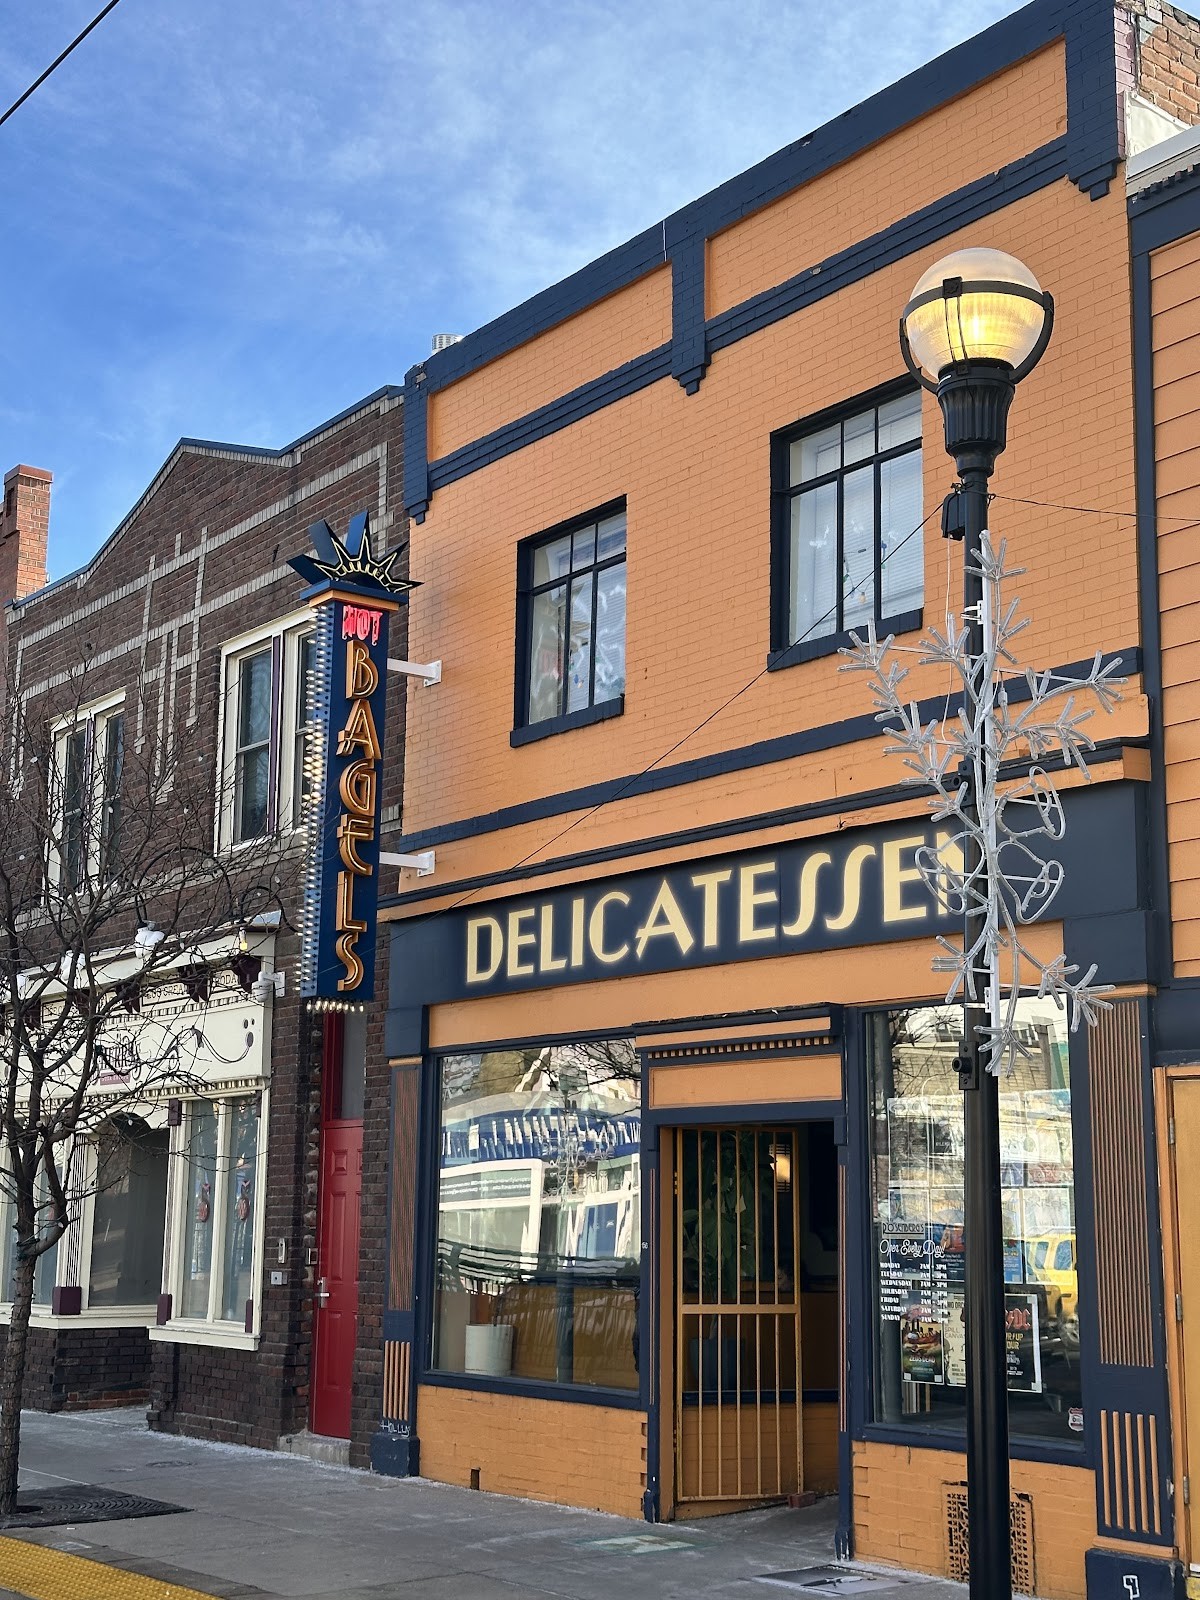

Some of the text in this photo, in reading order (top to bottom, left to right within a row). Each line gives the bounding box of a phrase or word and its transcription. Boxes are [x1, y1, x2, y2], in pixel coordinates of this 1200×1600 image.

[342, 605, 383, 646] HOT
[336, 640, 382, 993] BAGELS
[880, 1240, 899, 1256] Open
[900, 1240, 923, 1257] Every
[1005, 1308, 1031, 1330] /DC
